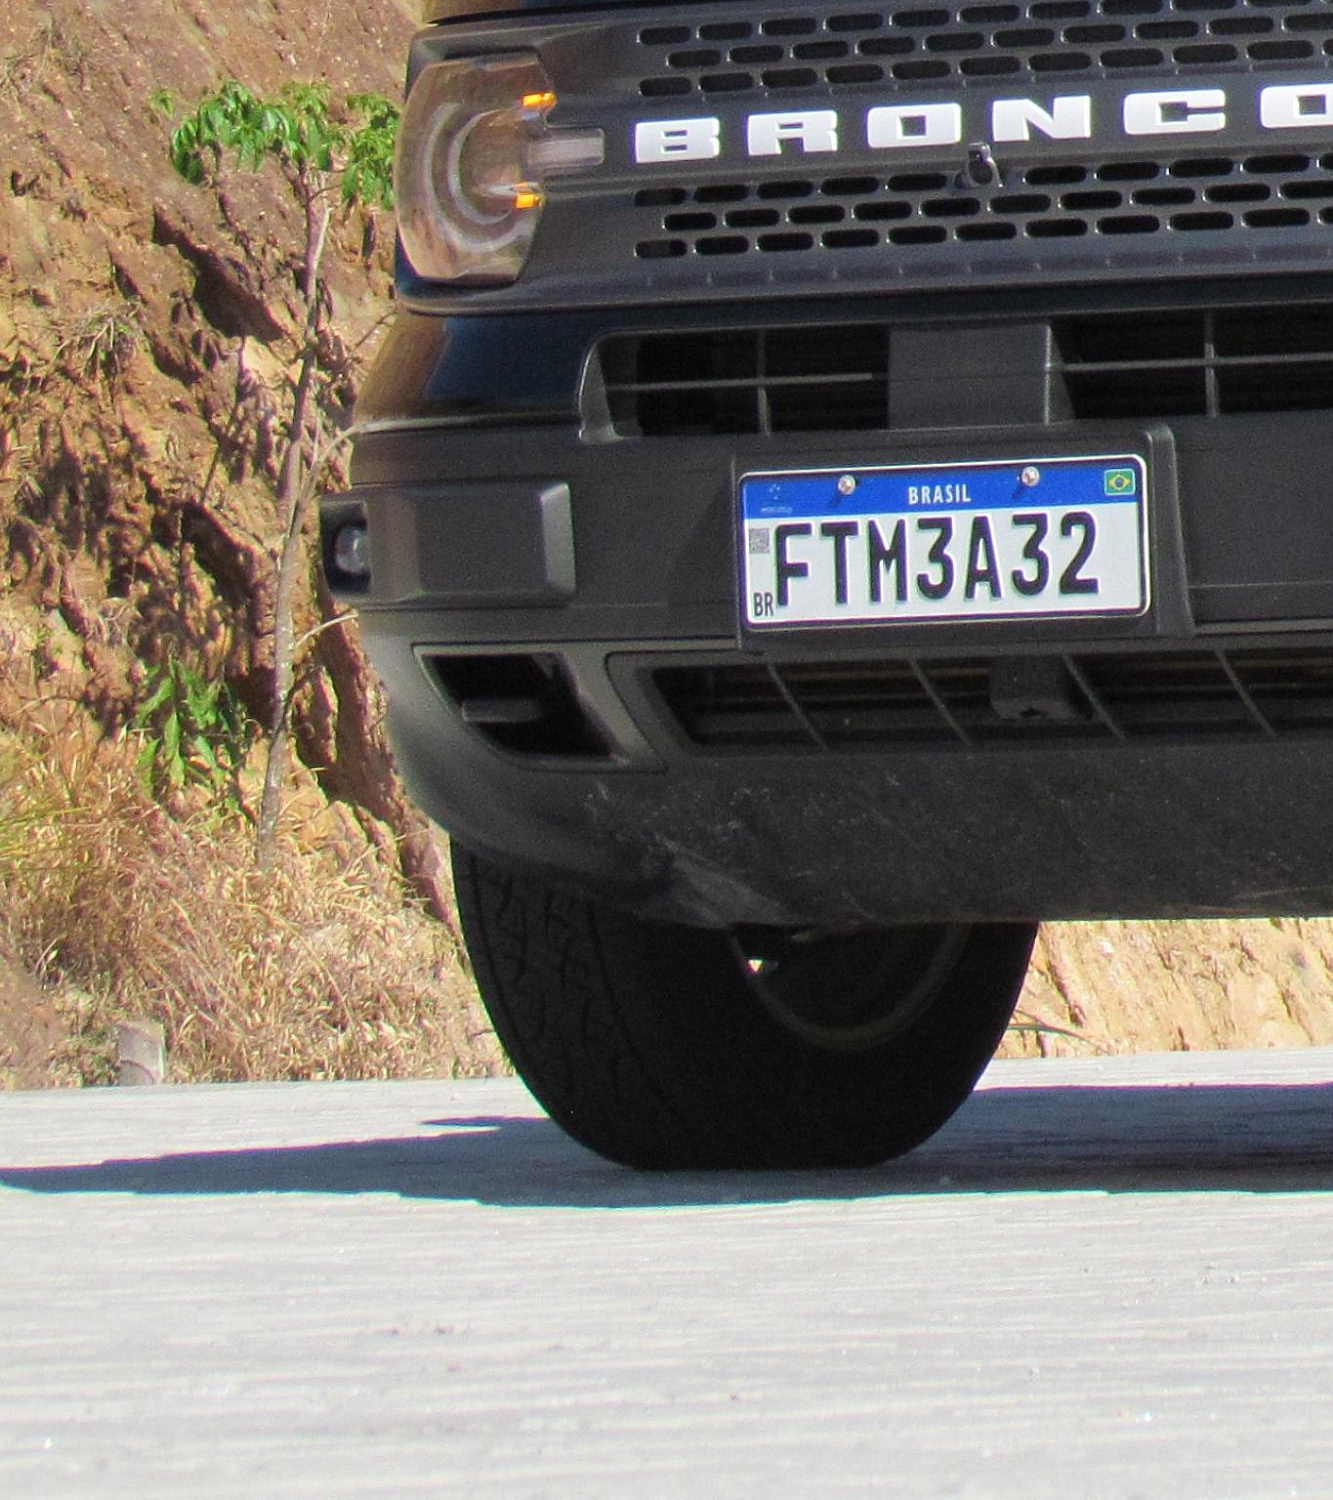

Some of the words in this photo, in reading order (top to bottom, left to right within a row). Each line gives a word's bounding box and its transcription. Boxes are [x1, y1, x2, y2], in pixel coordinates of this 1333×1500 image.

[908, 483, 971, 505] BRASIL
[774, 511, 1100, 606] FTM3A32
[753, 591, 774, 617] BR
